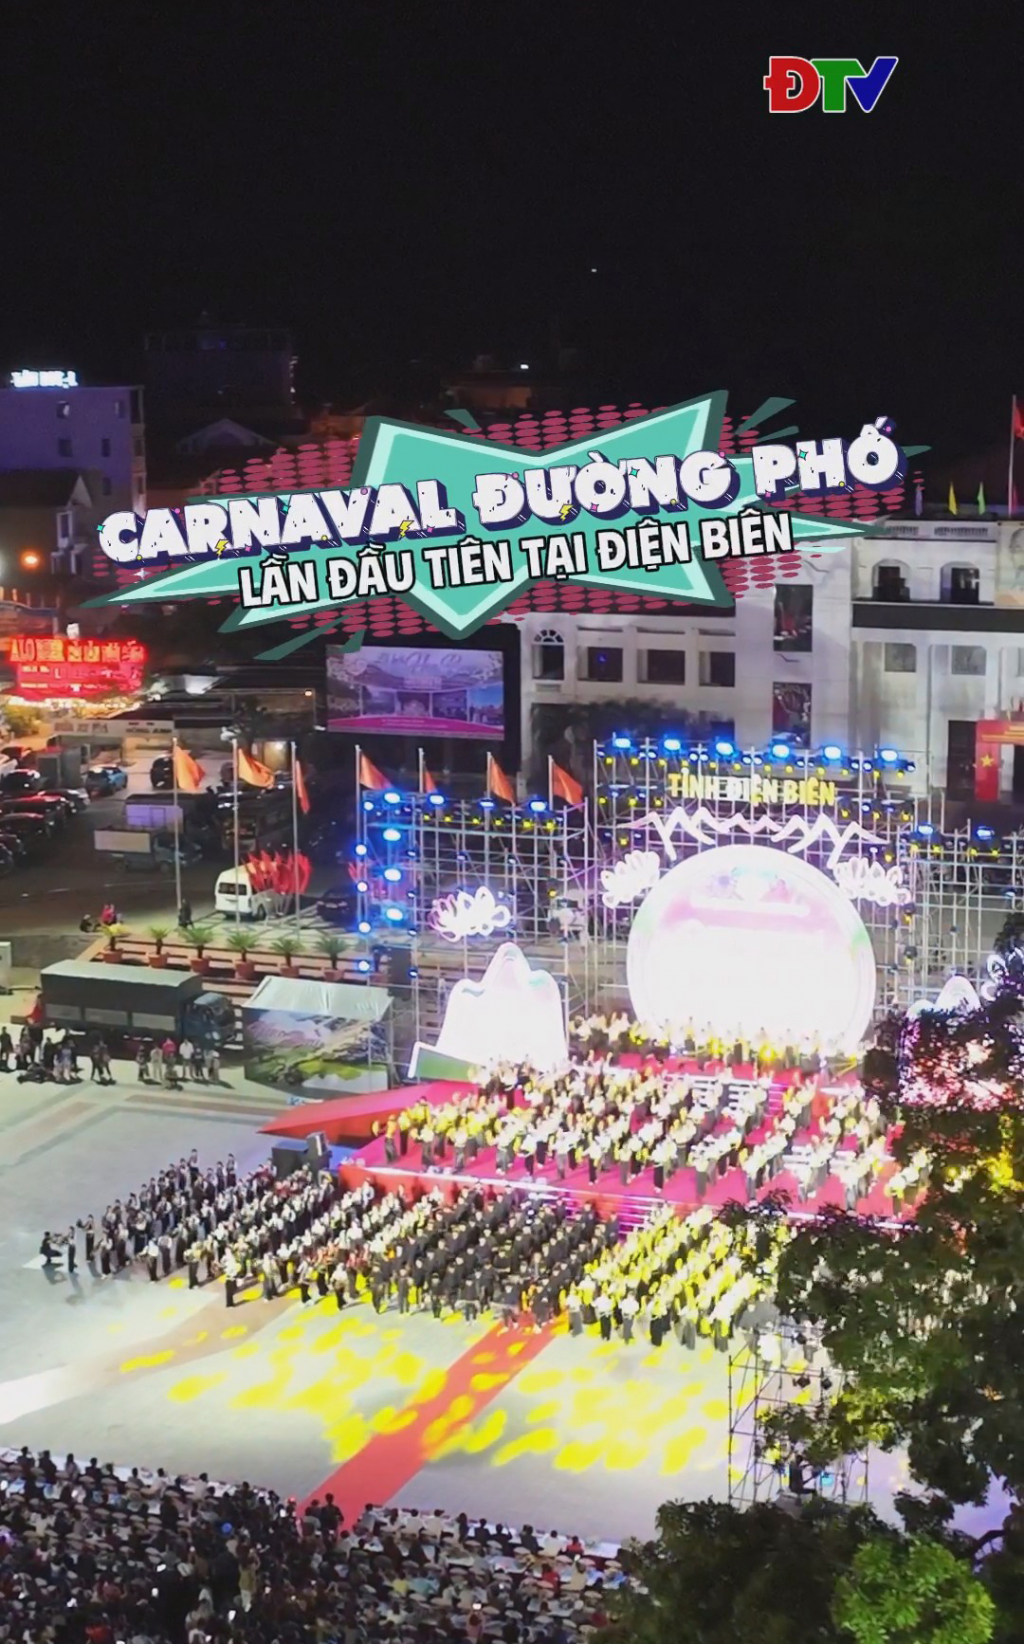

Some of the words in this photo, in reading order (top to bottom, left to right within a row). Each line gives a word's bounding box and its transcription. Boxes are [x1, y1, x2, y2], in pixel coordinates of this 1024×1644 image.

[668, 767, 718, 799] TỈNH
[727, 774, 778, 806] ĐIỆN
[784, 777, 836, 805] BIÊN
